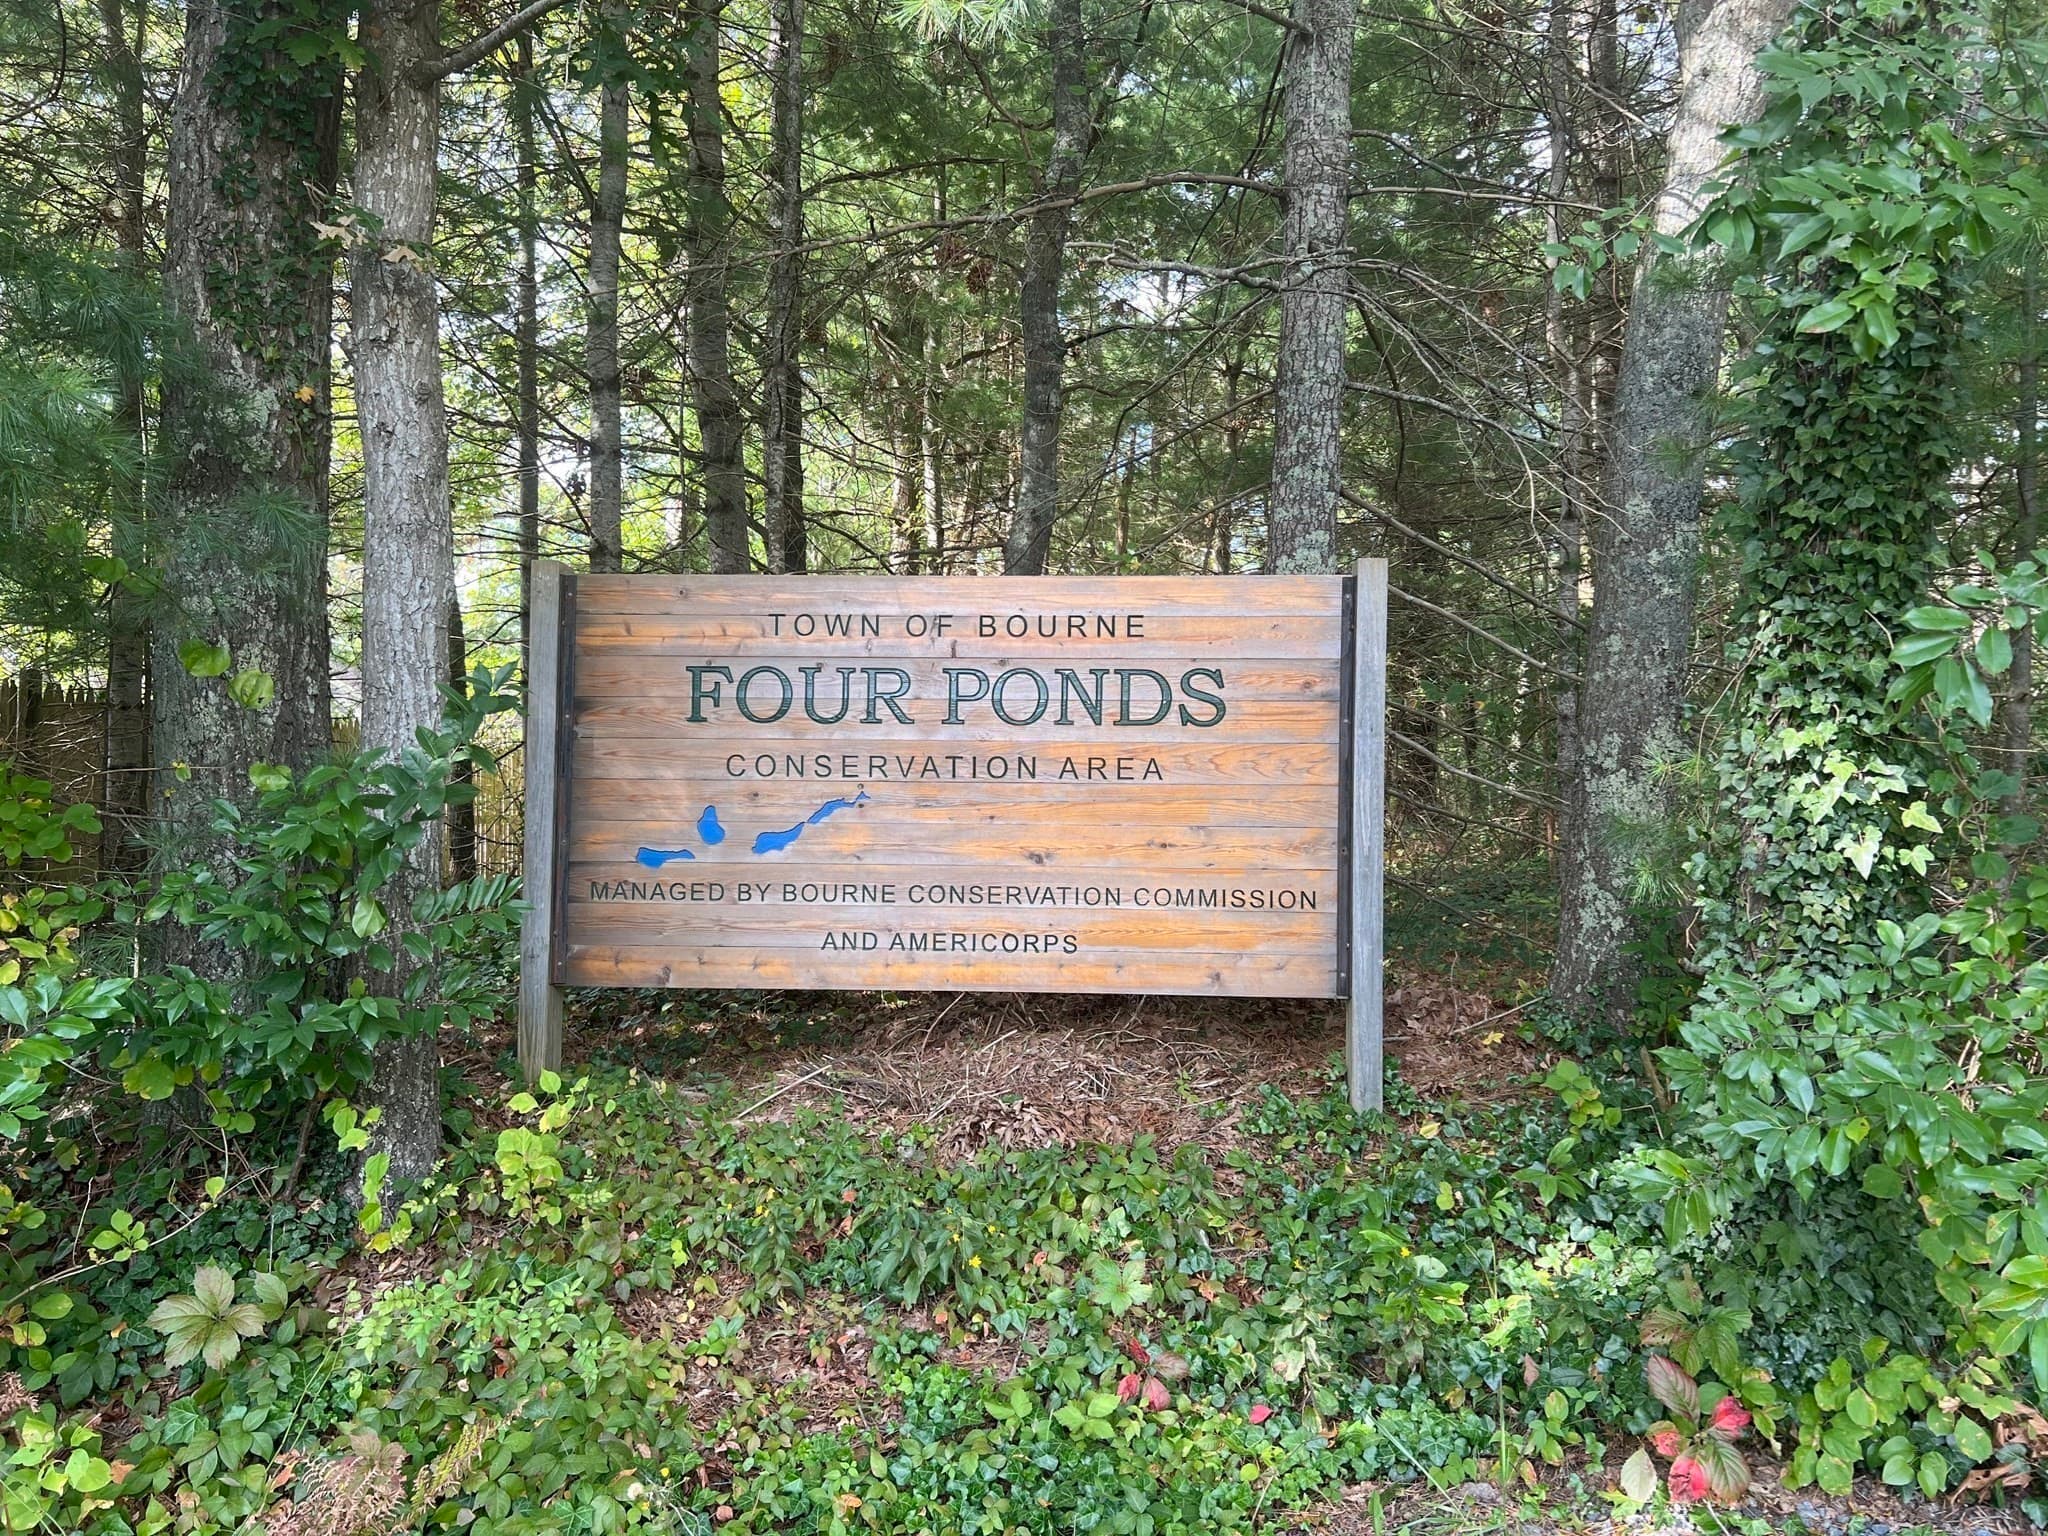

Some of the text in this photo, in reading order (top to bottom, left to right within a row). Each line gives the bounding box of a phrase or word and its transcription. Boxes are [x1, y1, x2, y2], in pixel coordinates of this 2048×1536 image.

[768, 613, 1146, 638] TOWN OF BOURNE
[685, 665, 1227, 727] FOUR PONDS
[726, 754, 1164, 781] CONSERVATION AREA
[590, 881, 1317, 910] MANAGED BY BOURNE CONSERVATION COMMISSION
[820, 931, 1078, 954] AND AMERICORPS
